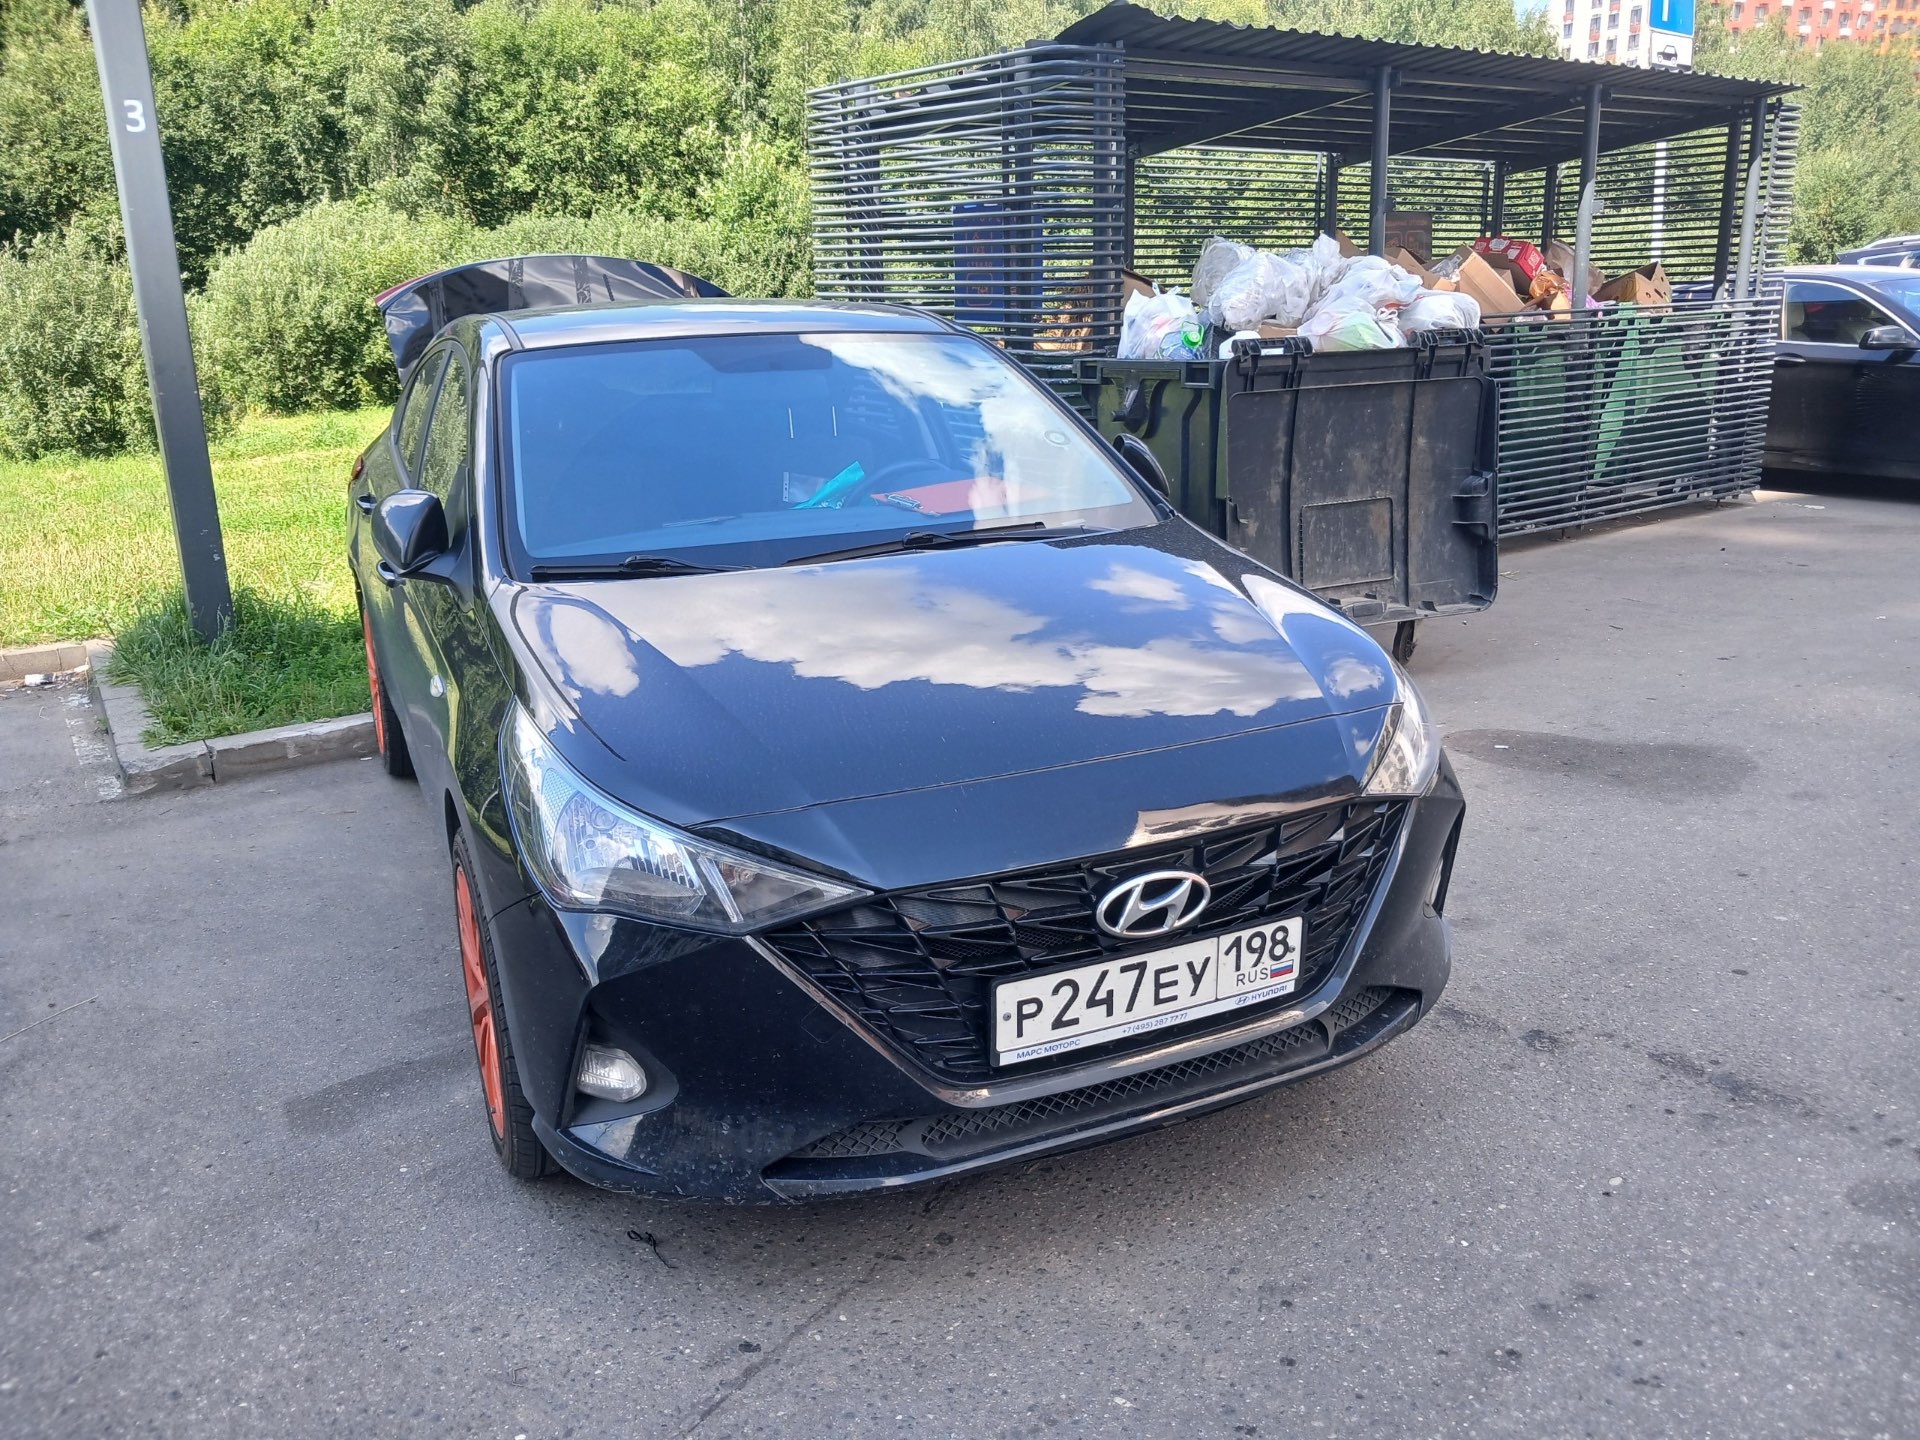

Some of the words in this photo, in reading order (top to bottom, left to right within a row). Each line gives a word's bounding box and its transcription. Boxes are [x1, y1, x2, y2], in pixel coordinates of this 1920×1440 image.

[123, 99, 146, 133] 3
[1223, 925, 1290, 973] 198
[1235, 967, 1269, 987] RUS
[1250, 984, 1288, 1001] HYUNDAI
[1122, 1025, 1132, 1034] +7
[1132, 1020, 1154, 1033] (495)
[1016, 1047, 1043, 1060] МАРС
[1043, 1038, 1082, 1054] МОТОРС
